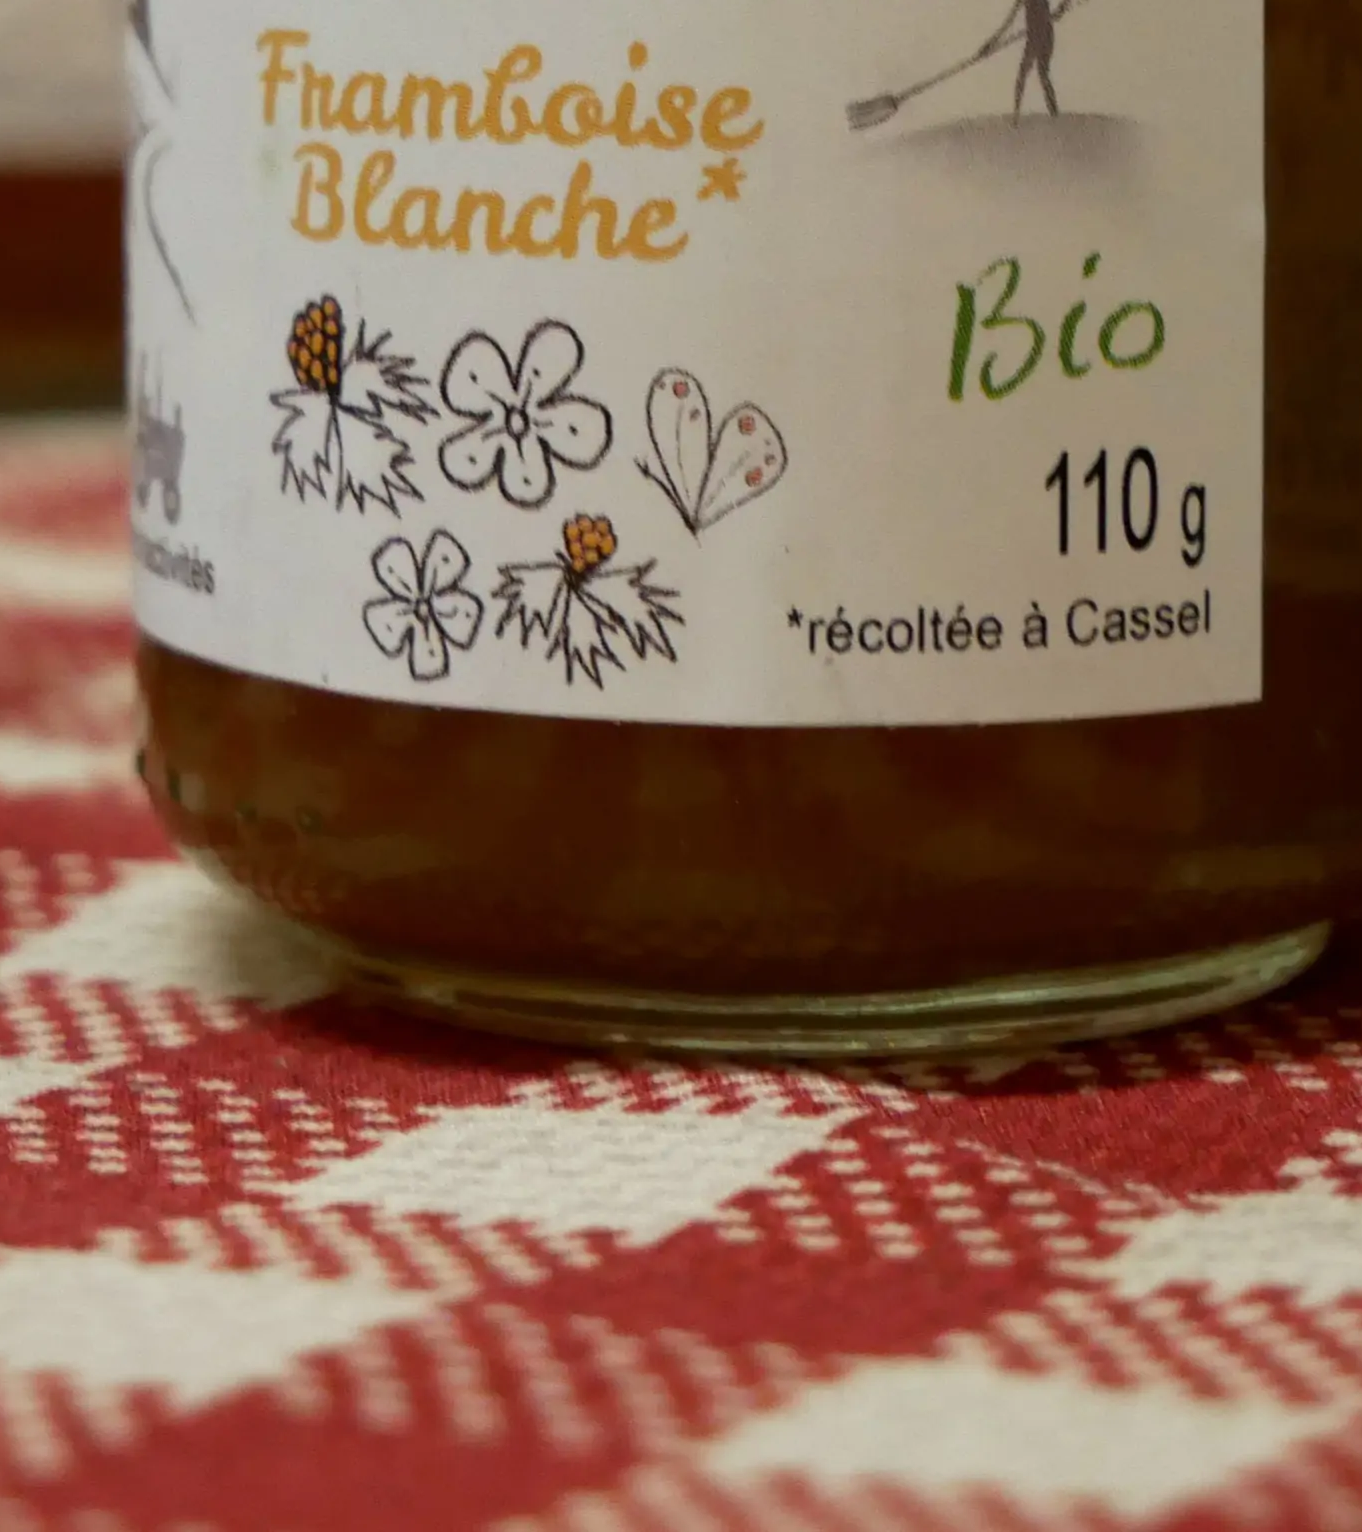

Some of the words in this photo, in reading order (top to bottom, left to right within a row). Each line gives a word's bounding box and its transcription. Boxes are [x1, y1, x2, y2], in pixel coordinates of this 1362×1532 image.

[256, 28, 765, 152] Framboise
[947, 252, 1166, 404] Bio
[1045, 446, 1159, 556] 110
[1180, 484, 1207, 569] g
[1022, 601, 1049, 650] à
[1065, 589, 1212, 647] Cassel
